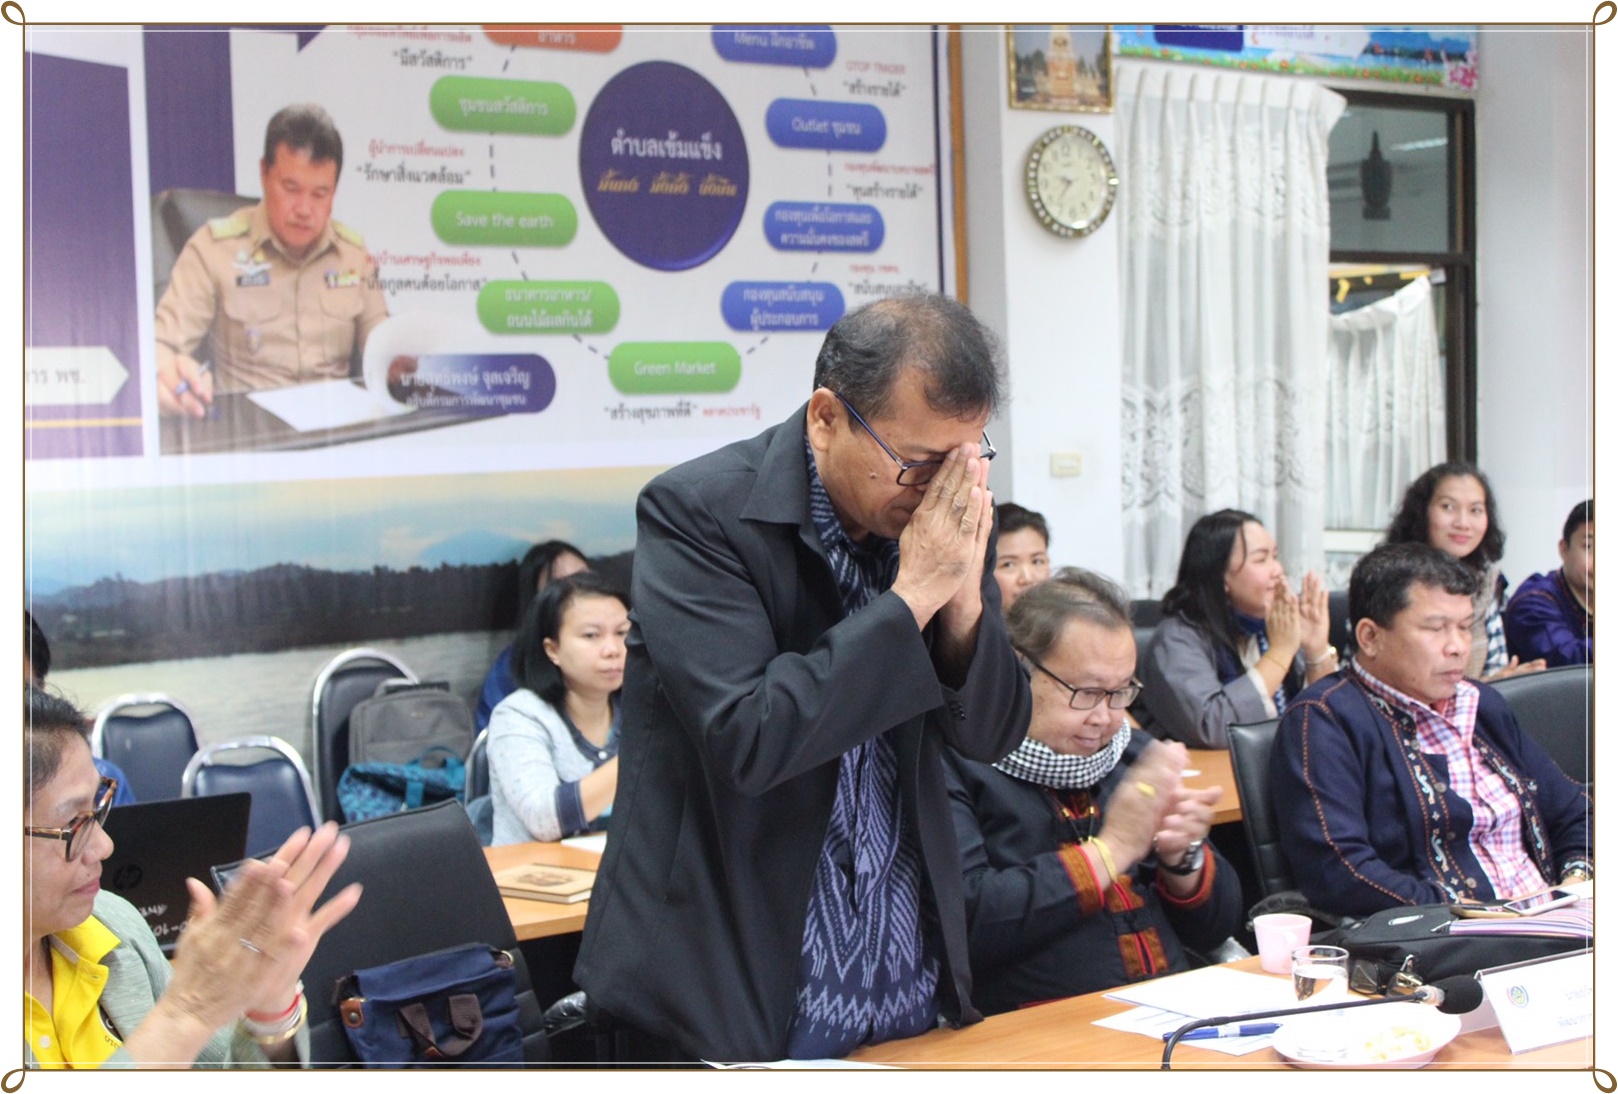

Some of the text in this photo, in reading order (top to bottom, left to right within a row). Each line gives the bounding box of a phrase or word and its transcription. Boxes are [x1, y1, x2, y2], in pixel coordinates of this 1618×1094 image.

[734, 31, 767, 47] Menu
[792, 117, 829, 134] Outlet
[611, 129, 723, 161] ตำบลเข้มแข็ง
[456, 212, 554, 229] Save the earth
[633, 360, 717, 376] Green Market
